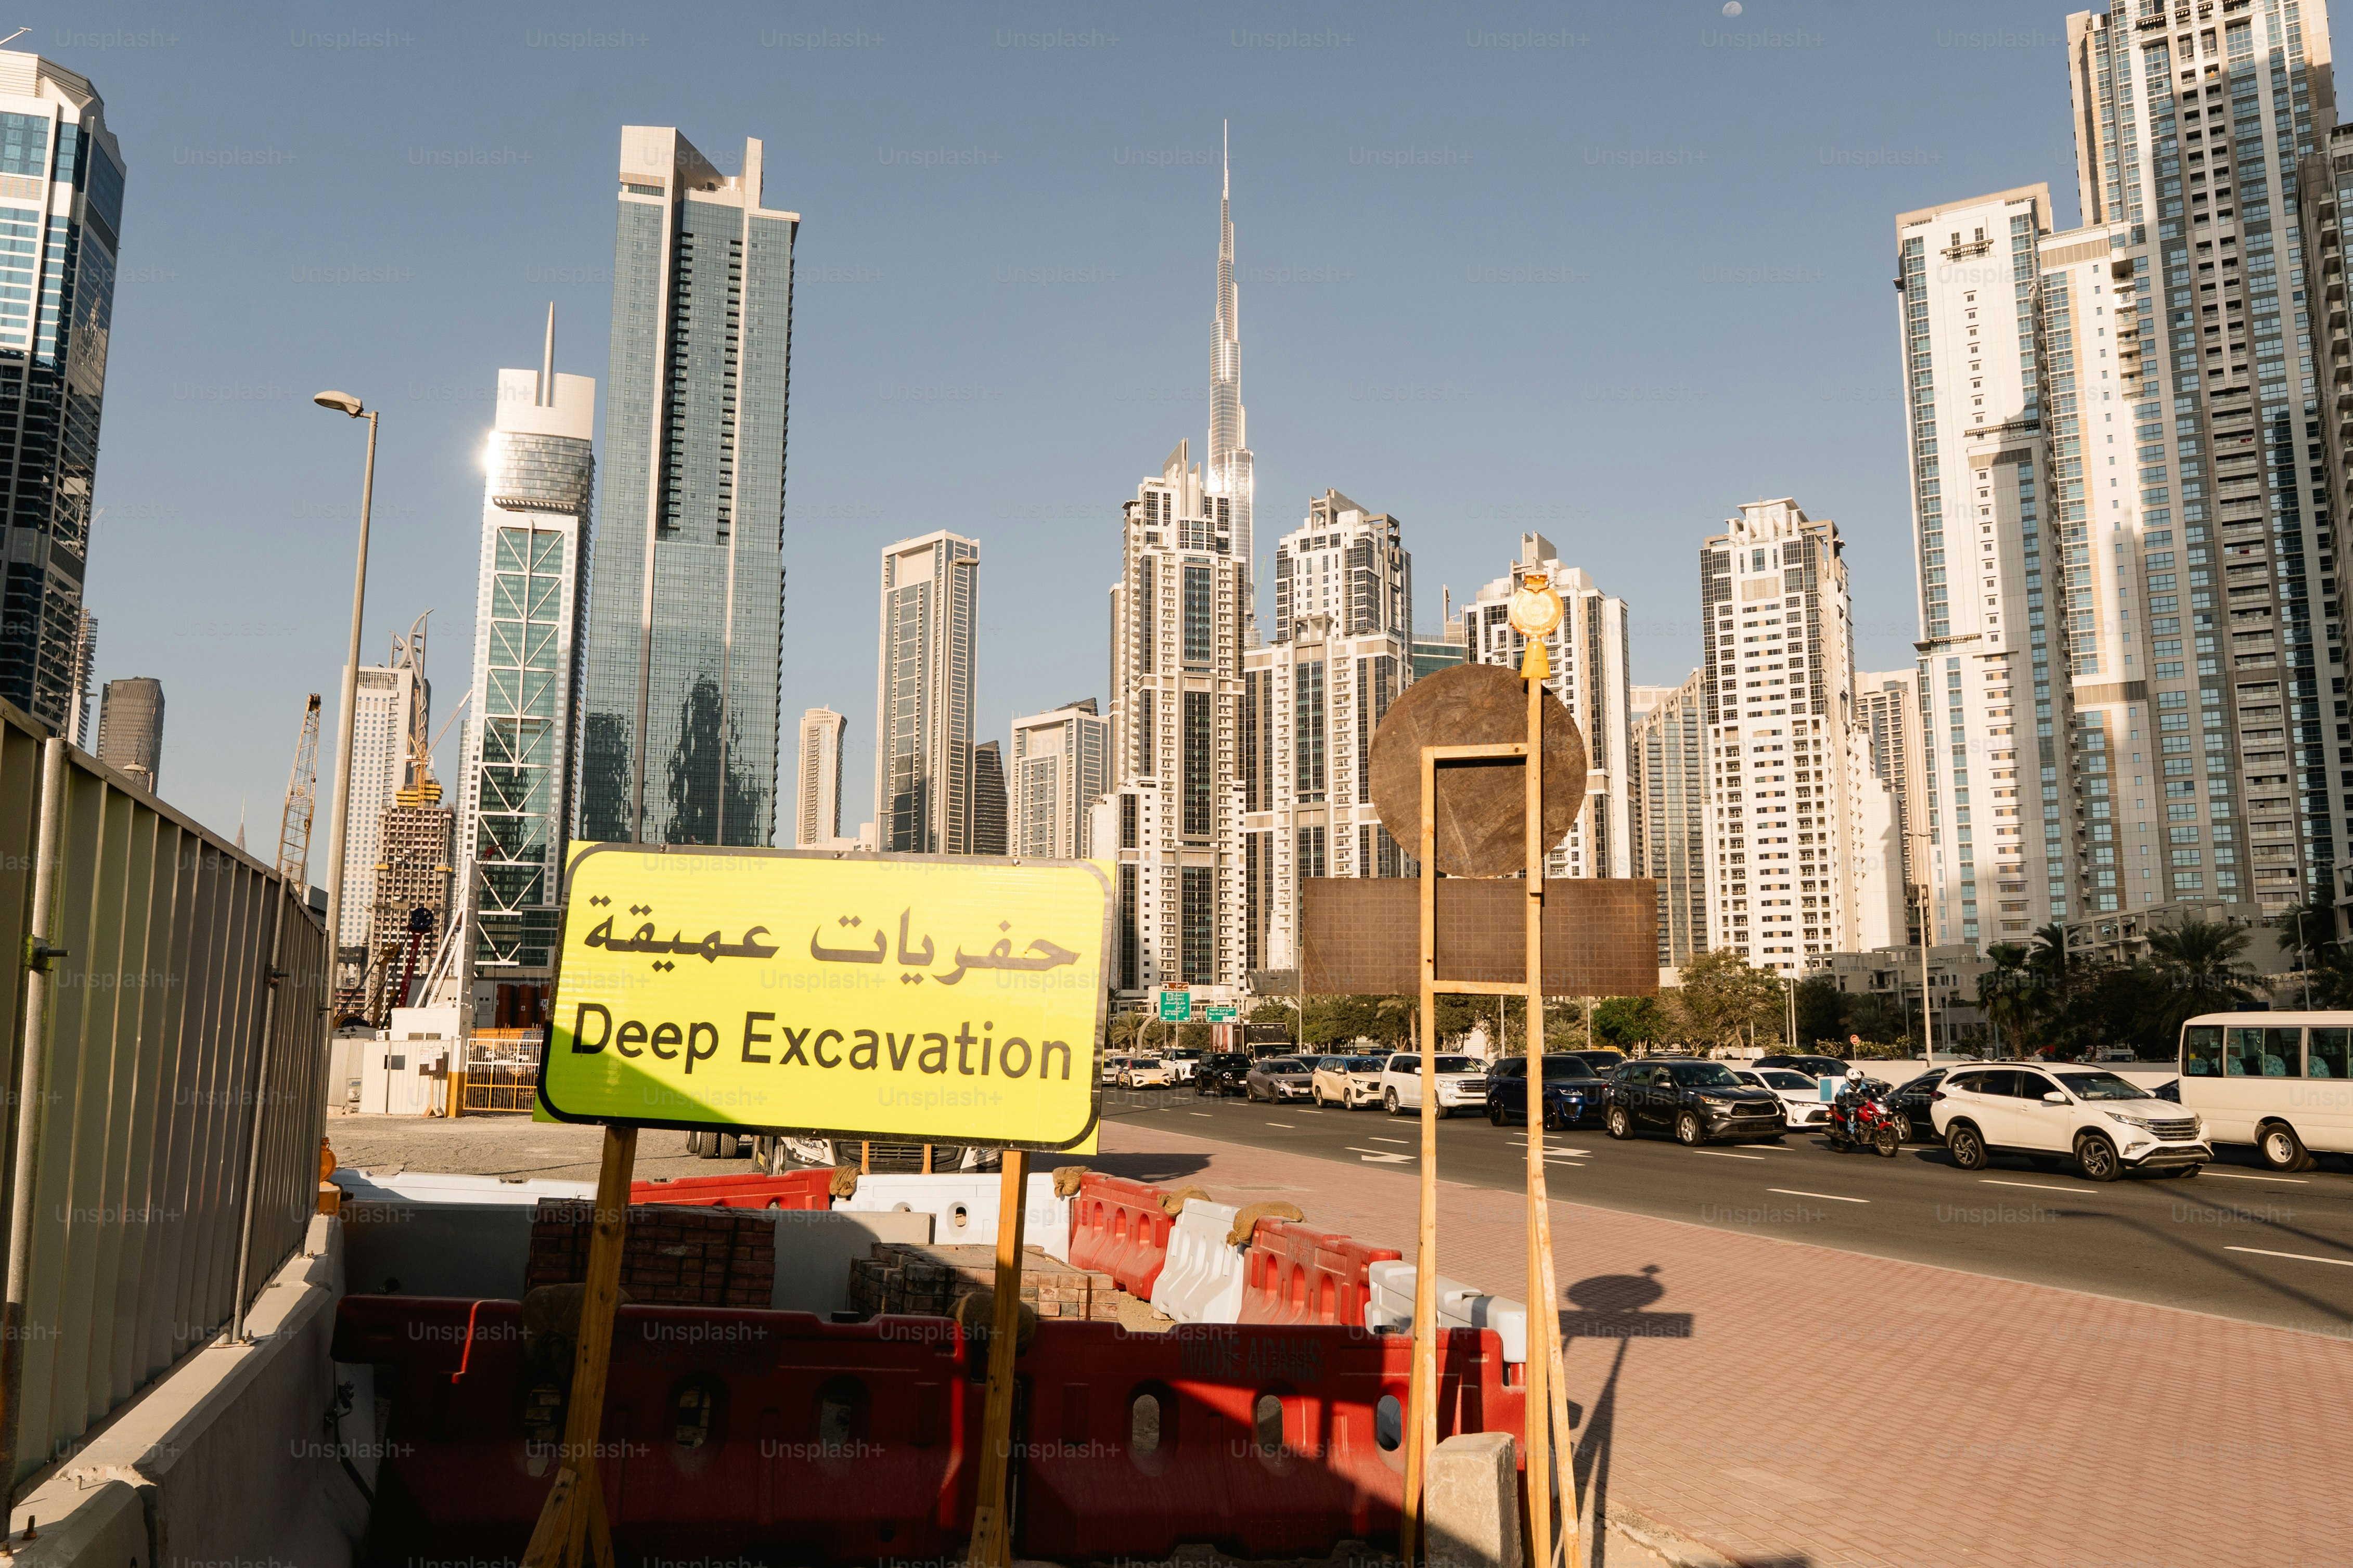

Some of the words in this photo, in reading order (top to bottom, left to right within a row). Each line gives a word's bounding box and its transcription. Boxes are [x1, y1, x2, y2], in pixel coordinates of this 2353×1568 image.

[584, 895, 780, 973] عميقة
[811, 906, 1082, 986] حفريات
[571, 1002, 720, 1075] Deep
[741, 1011, 1072, 1081] Excavation
